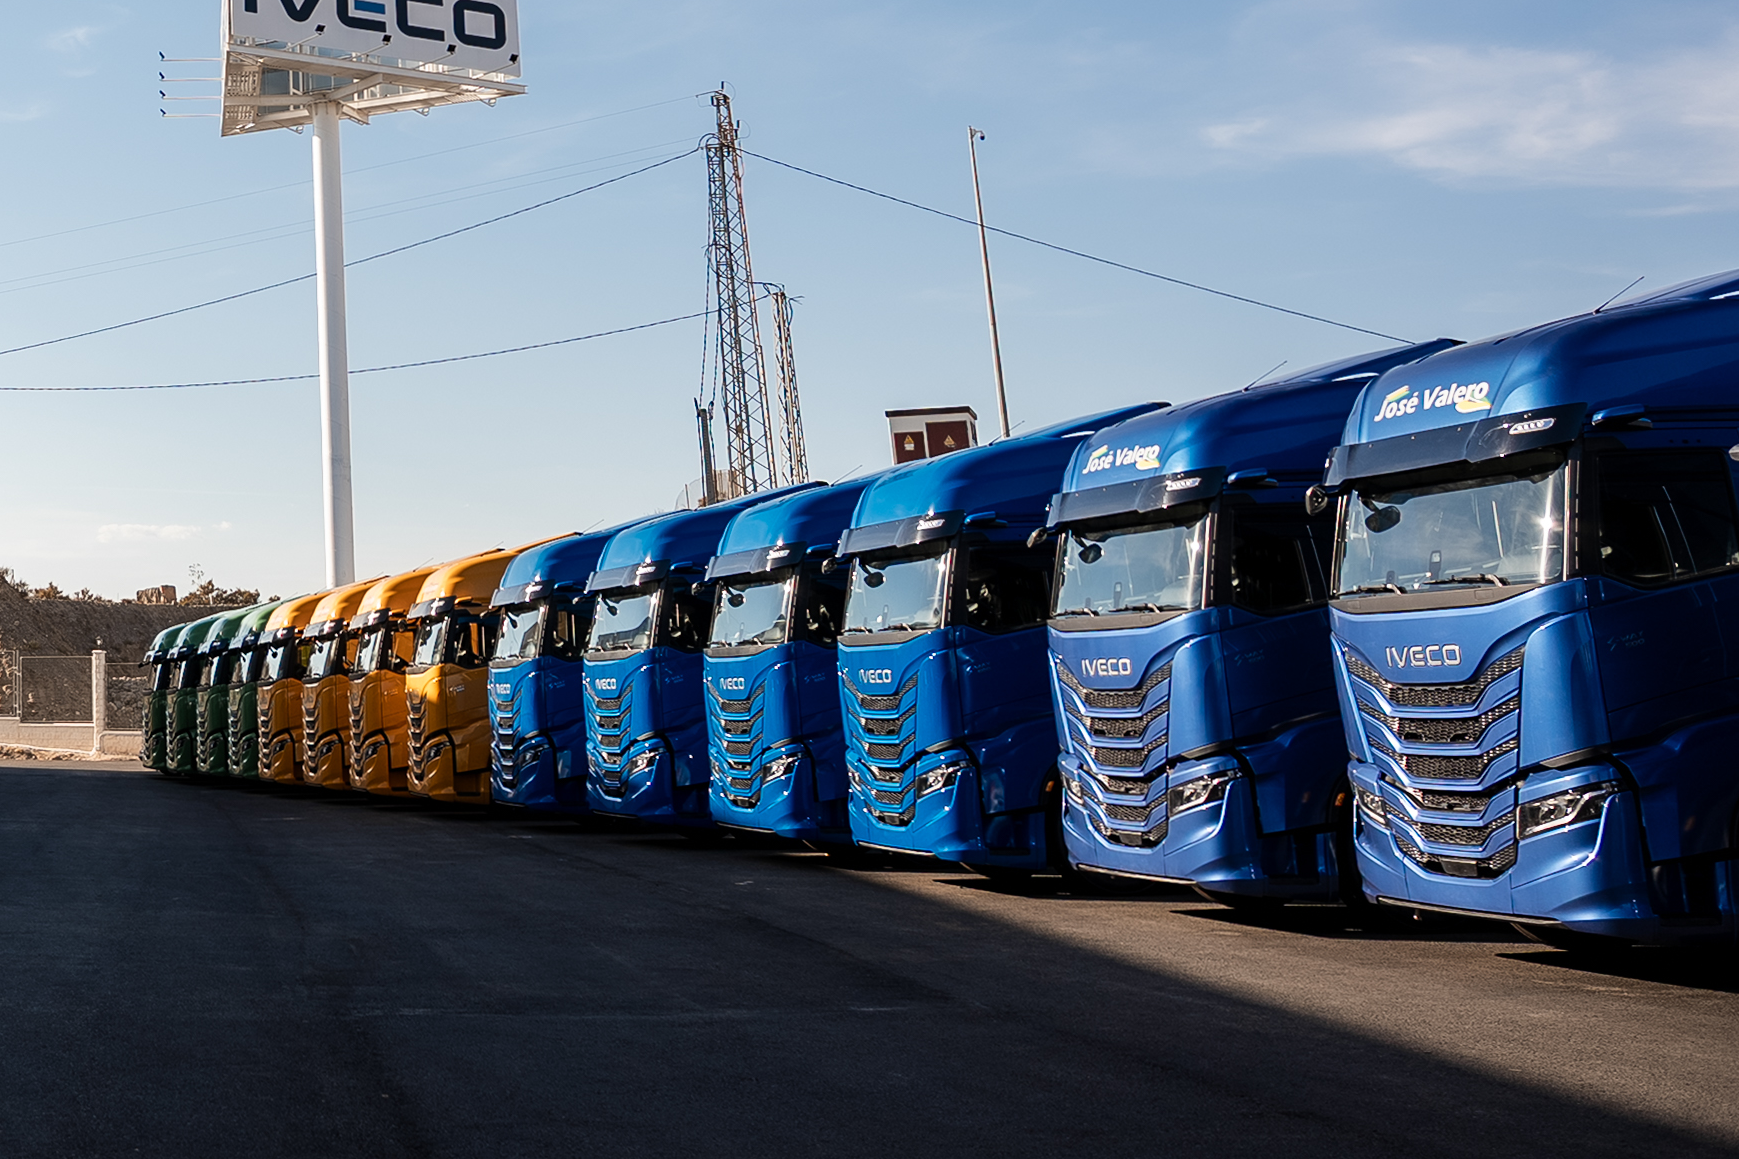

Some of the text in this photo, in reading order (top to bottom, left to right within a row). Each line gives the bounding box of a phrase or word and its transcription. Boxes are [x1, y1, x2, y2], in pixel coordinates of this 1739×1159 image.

[1374, 381, 1490, 422] José Valero
[1082, 445, 1161, 475] José Valero
[1081, 657, 1133, 677] IVECO
[1385, 643, 1462, 669] IVECO
[858, 668, 892, 684] IVECO
